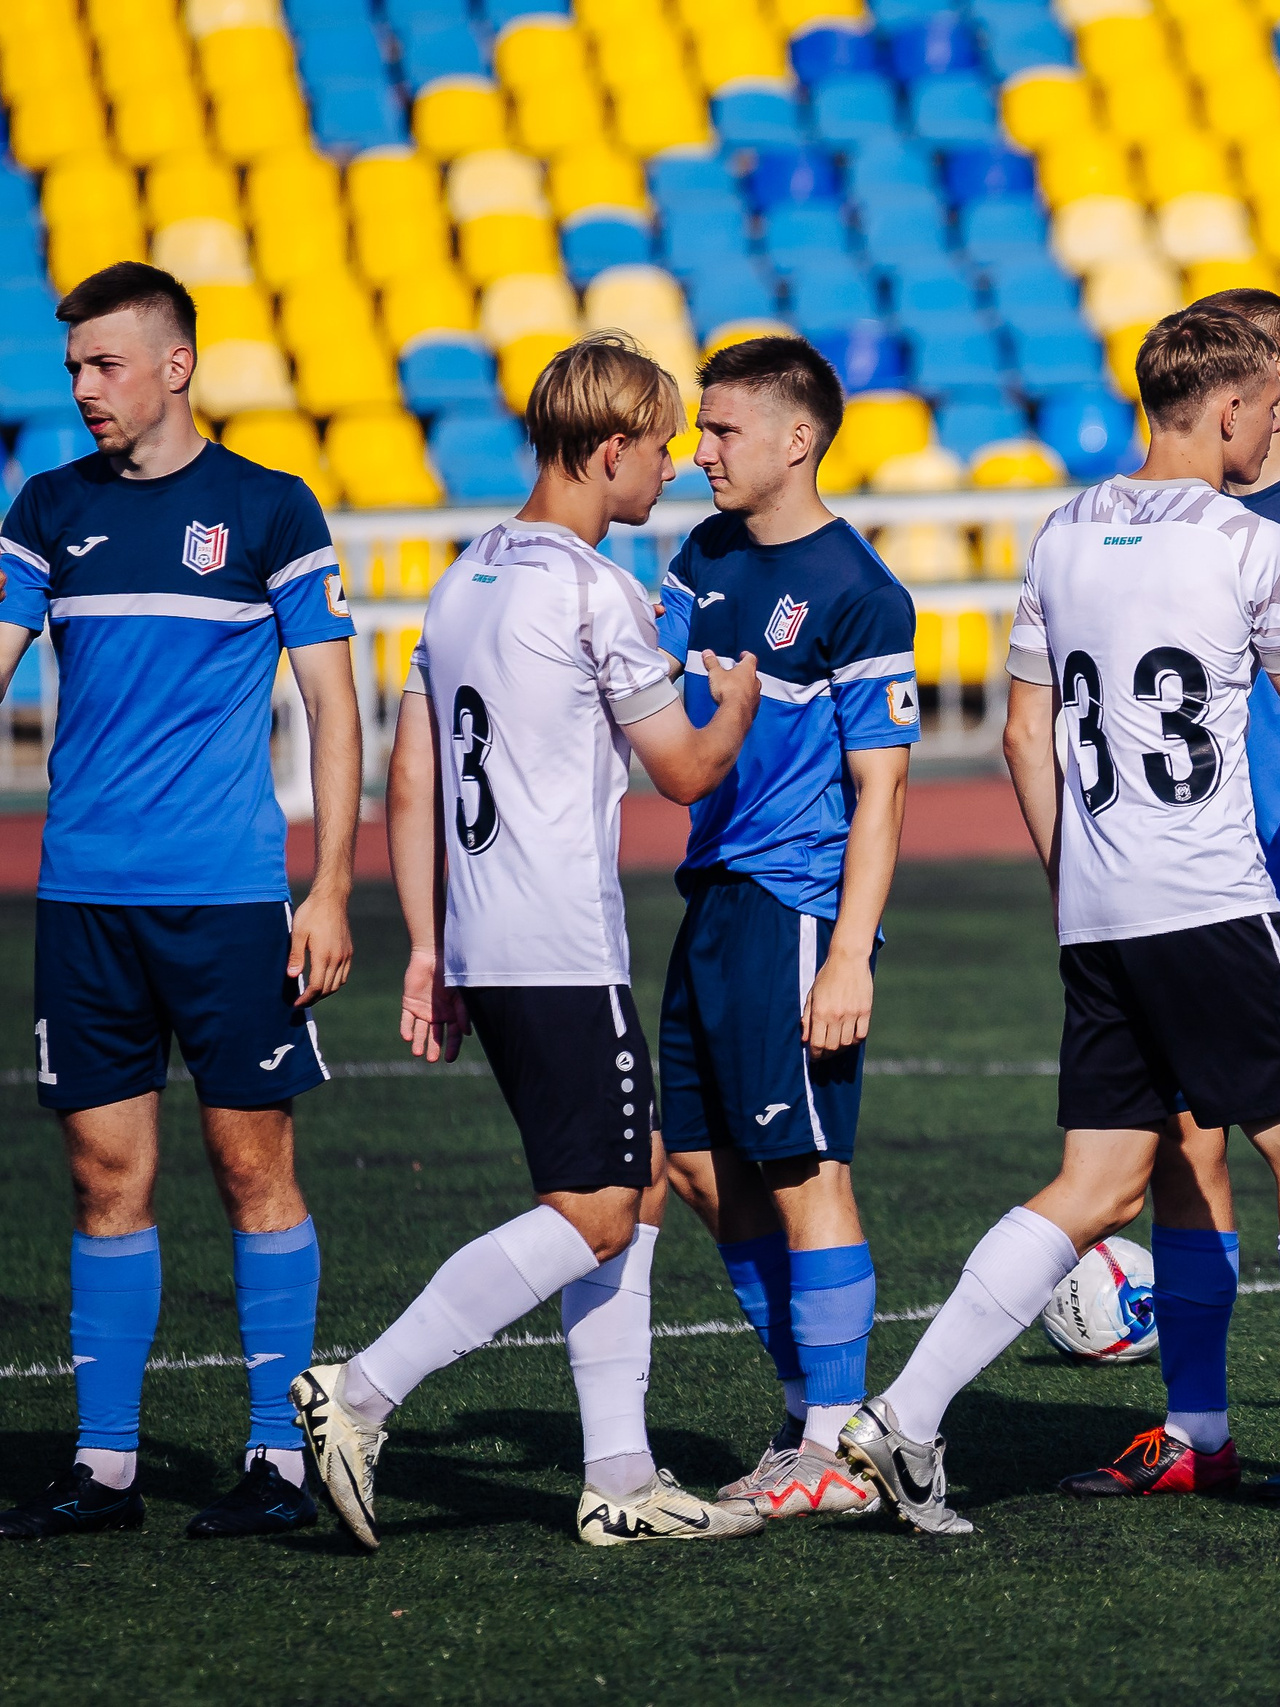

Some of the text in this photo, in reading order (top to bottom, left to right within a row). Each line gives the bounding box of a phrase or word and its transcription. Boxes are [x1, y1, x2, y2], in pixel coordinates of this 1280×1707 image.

[1103, 536, 1143, 546] СИБУР
[1062, 646, 1223, 818] 33
[451, 684, 500, 857] 3
[34, 1018, 57, 1086] 1
[1070, 1279, 1091, 1341] DEMIX
